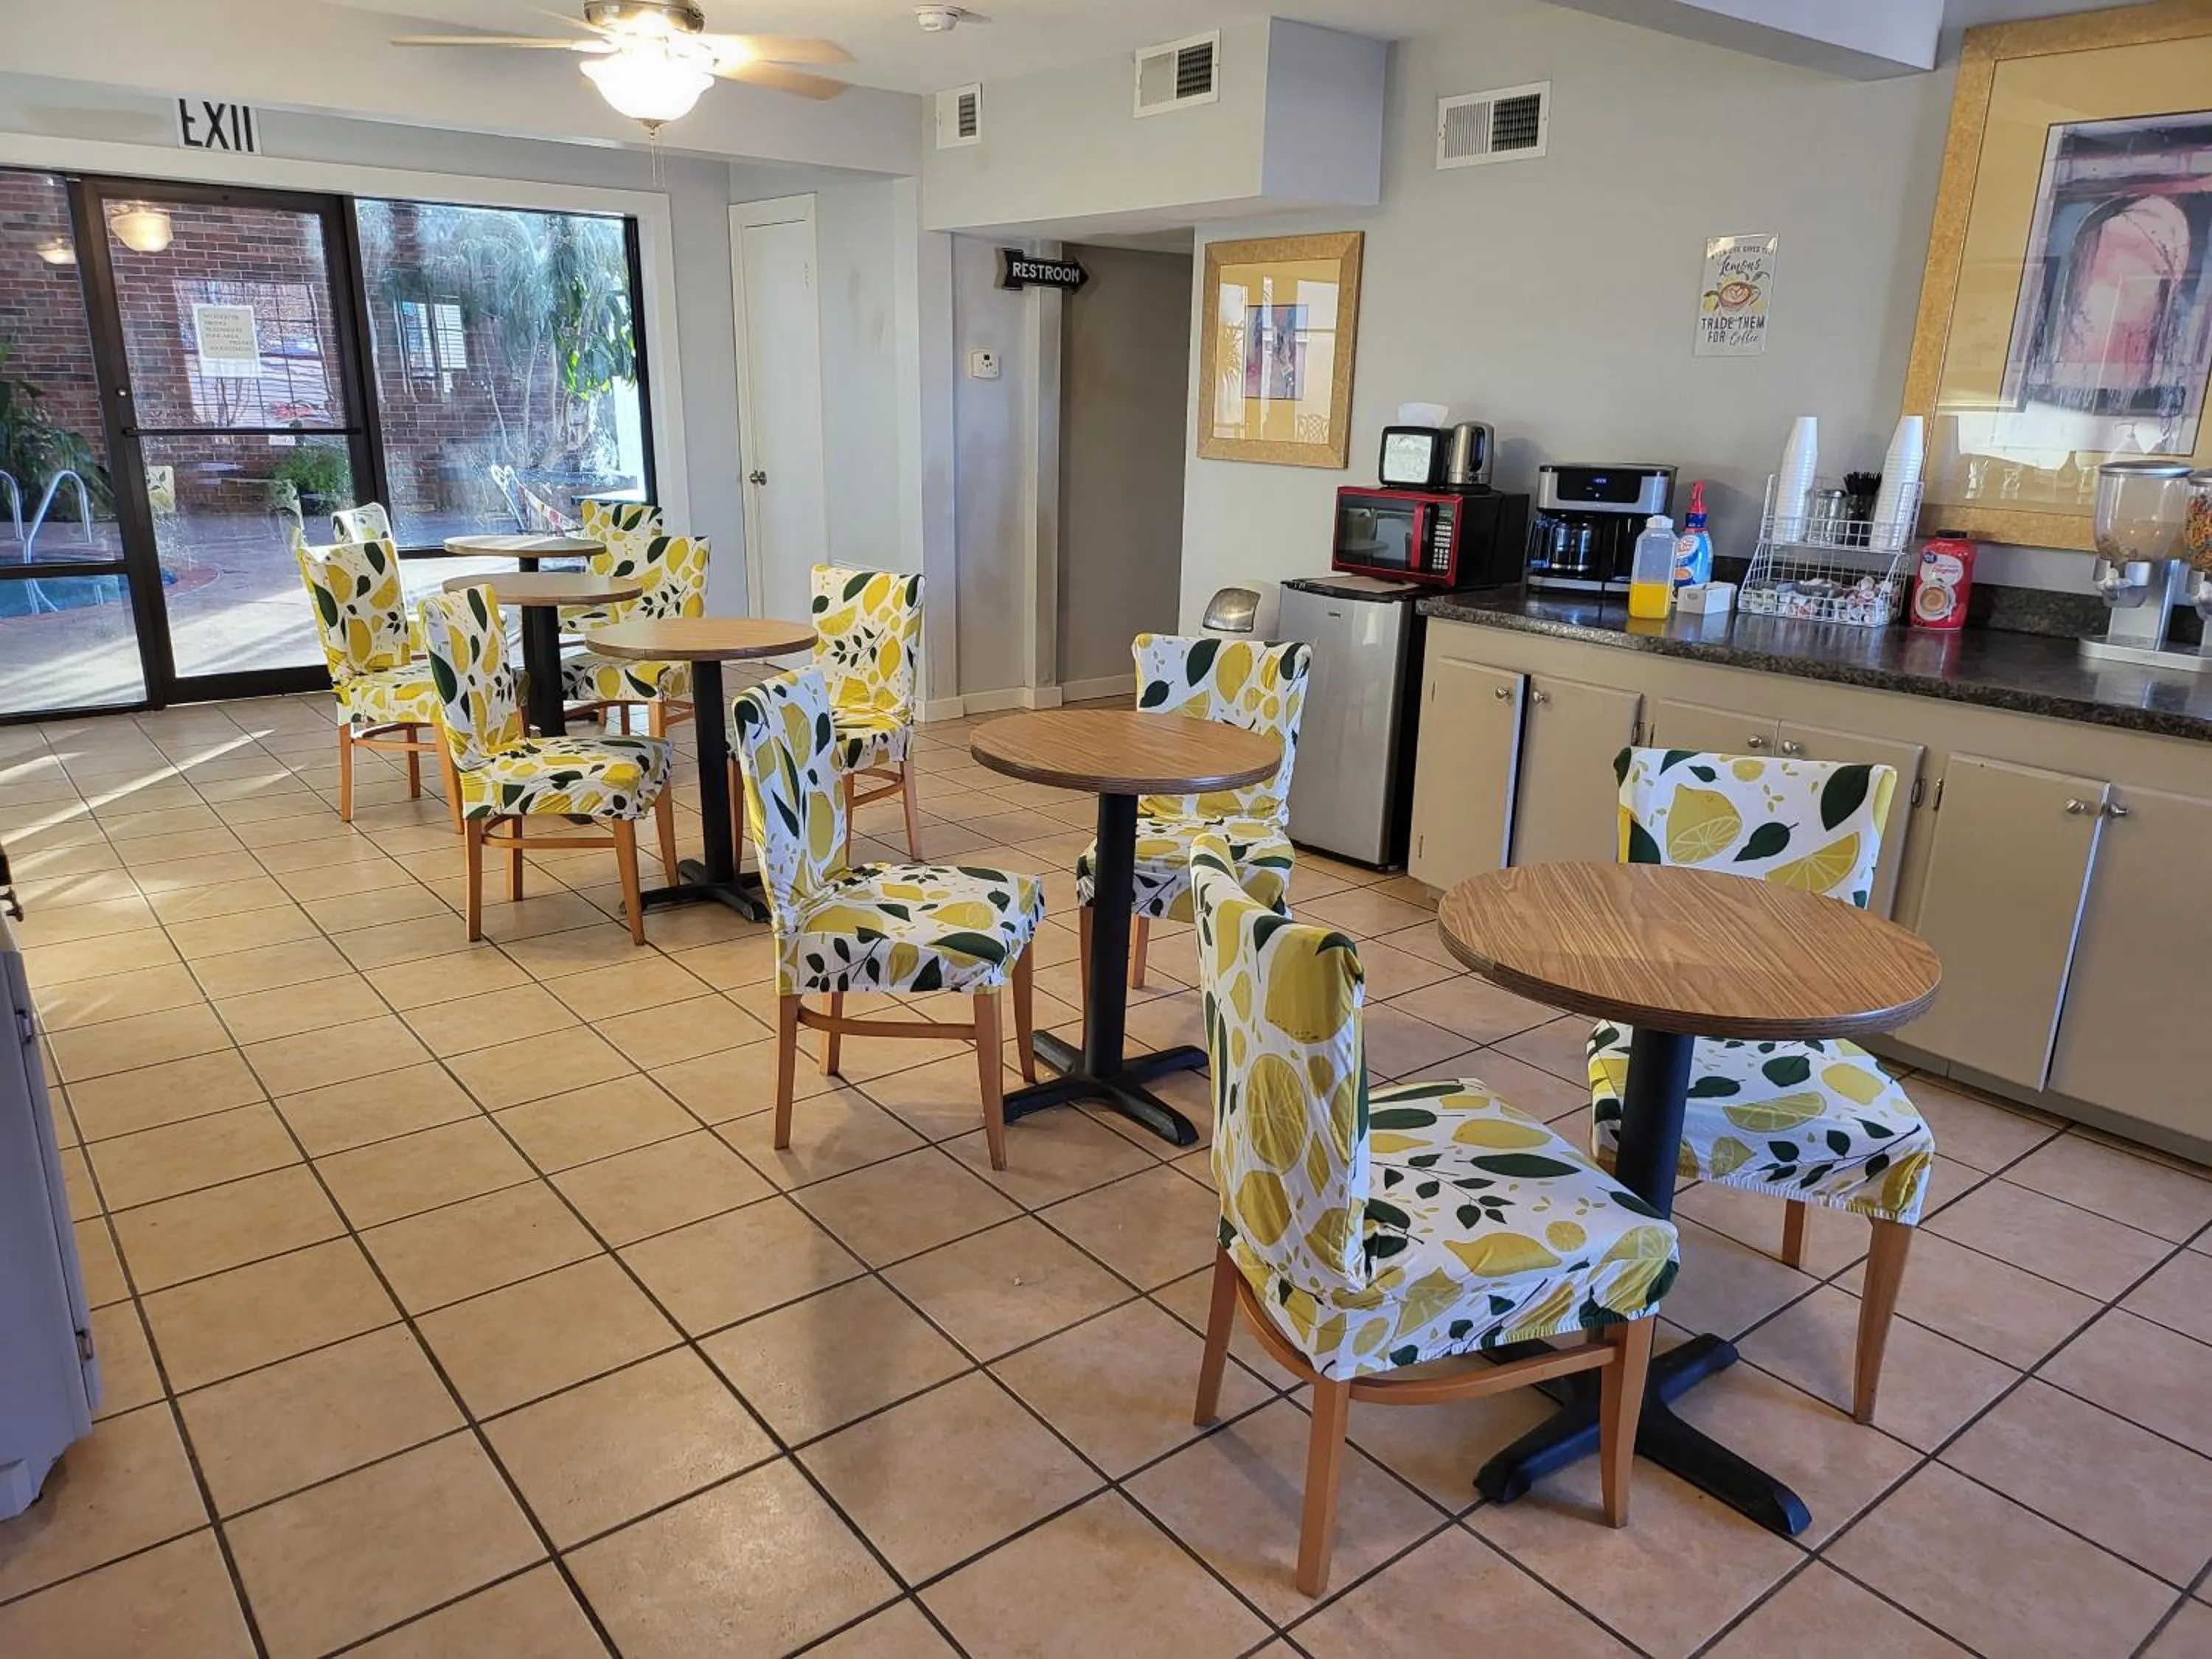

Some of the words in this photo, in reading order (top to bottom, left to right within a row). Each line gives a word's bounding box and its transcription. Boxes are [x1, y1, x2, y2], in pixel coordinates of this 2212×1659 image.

[1012, 262, 1080, 284] RESTROOM
[1701, 316, 1733, 330] TRADE
[1738, 316, 1765, 330] THEM
[1707, 330, 1726, 343] FOR
